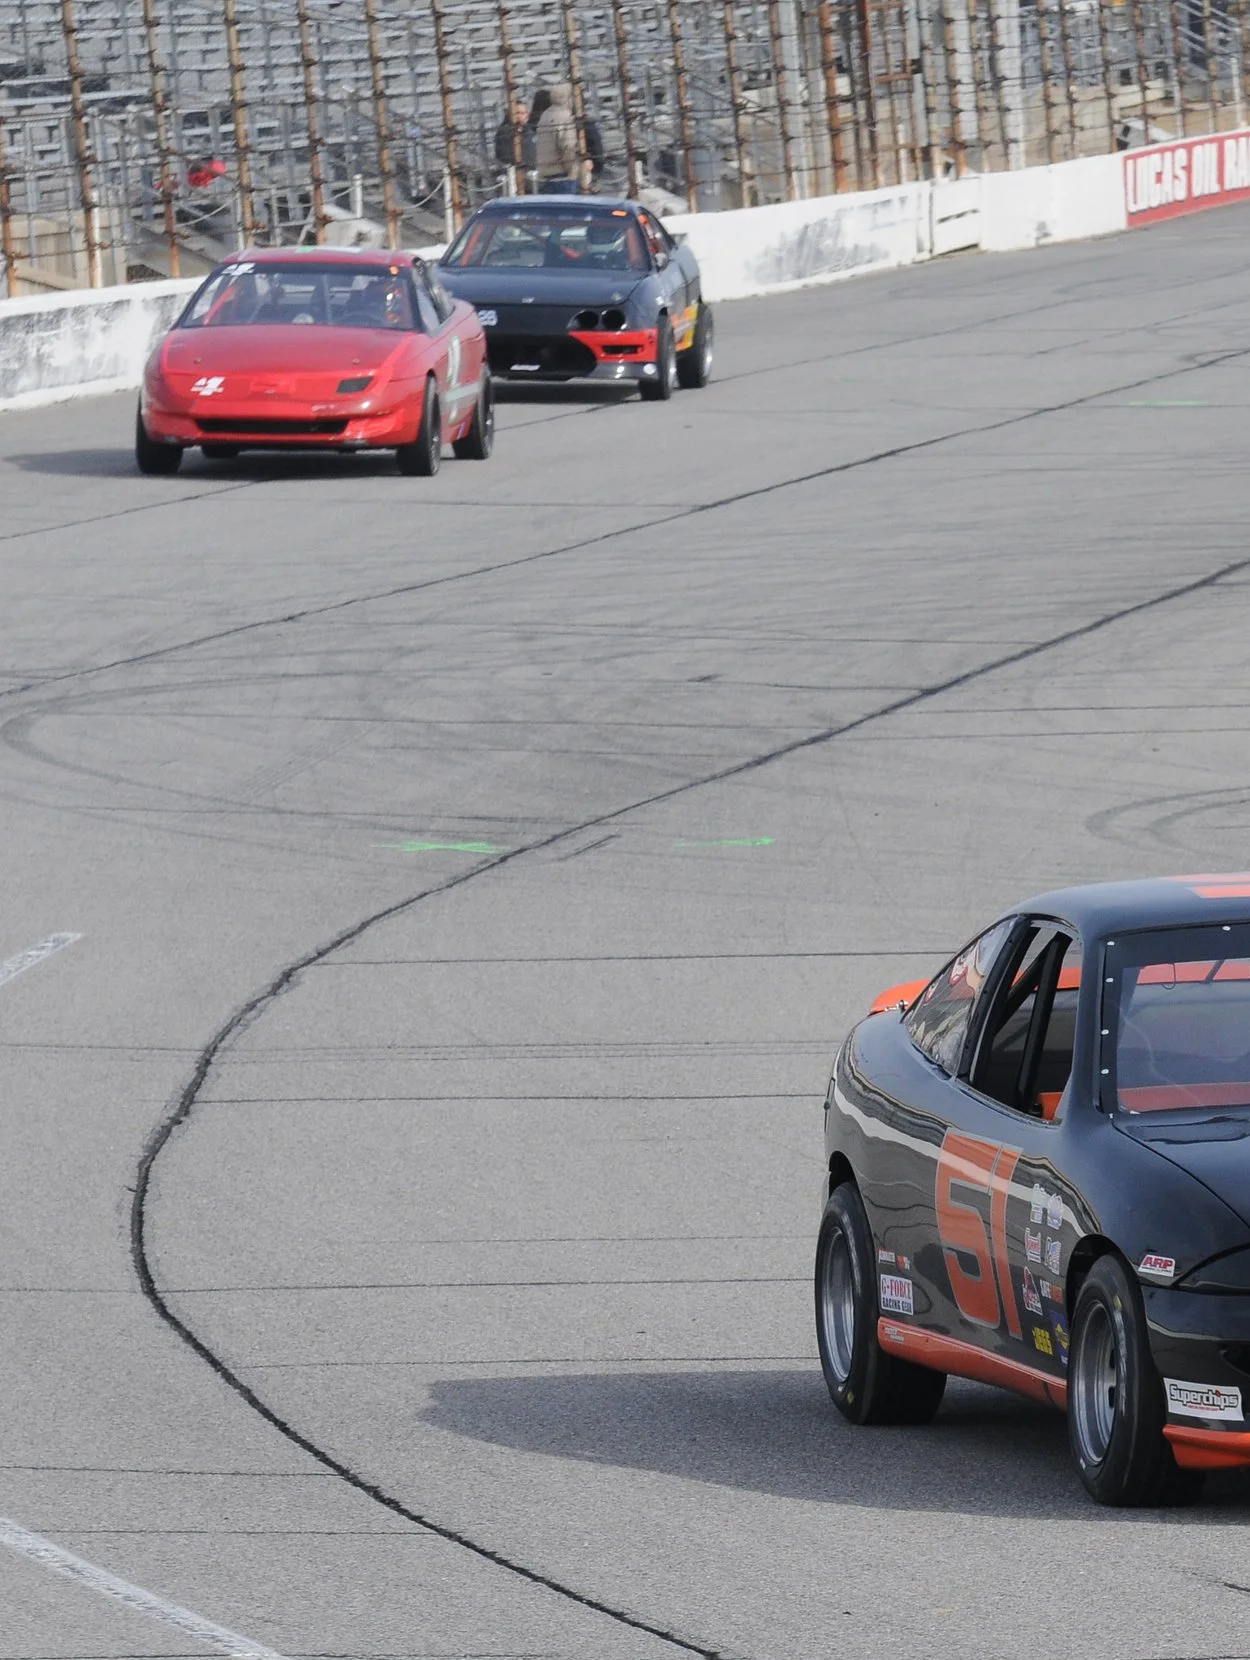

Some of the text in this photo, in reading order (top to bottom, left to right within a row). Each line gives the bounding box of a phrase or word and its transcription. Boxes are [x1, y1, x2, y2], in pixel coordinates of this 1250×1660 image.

[1126, 147, 1188, 213] LUCAS
[1191, 142, 1220, 198] OIL
[191, 376, 225, 395] 4
[935, 1127, 1023, 1340] 51
[1142, 1256, 1174, 1269] ARP
[1169, 1384, 1238, 1411] Superchips
